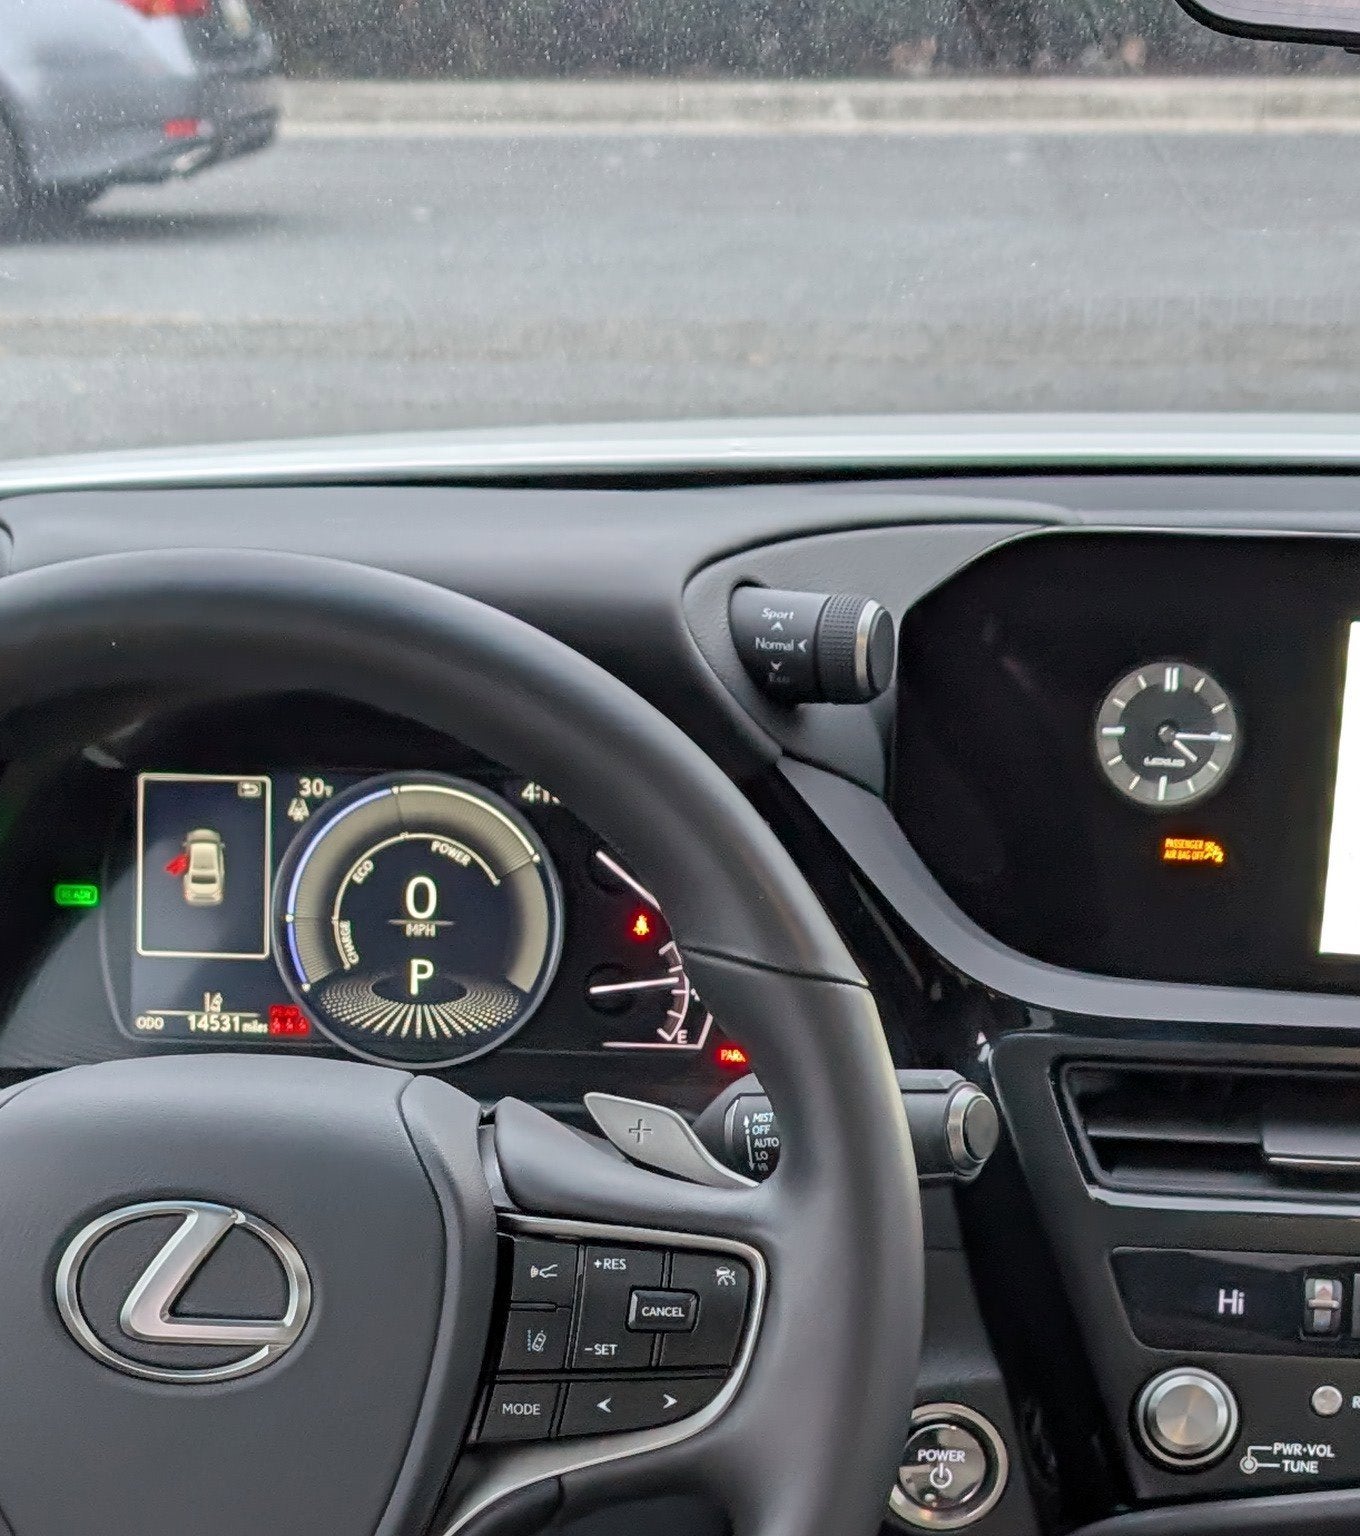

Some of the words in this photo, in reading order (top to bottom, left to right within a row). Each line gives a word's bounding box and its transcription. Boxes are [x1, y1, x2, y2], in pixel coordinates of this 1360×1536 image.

[761, 607, 795, 621] Sport
[755, 637, 795, 651] Normal
[431, 841, 472, 867] POWER
[352, 859, 375, 885] ECO
[405, 875, 438, 919] 0
[405, 923, 437, 937] MPH
[409, 959, 435, 995] P
[135, 1016, 165, 1030] ODO
[187, 1013, 240, 1033] 14531
[676, 1029, 688, 1044] E
[752, 1112, 774, 1123] MIST
[751, 1124, 771, 1136] OFF
[754, 1137, 780, 1149] AUTO
[754, 1150, 769, 1161] LO
[1217, 1288, 1245, 1315] Hi
[641, 1305, 687, 1318] CANCEL
[501, 1402, 542, 1416] MODE
[916, 1448, 967, 1464] POWER
[1283, 1460, 1320, 1474] TUNE
